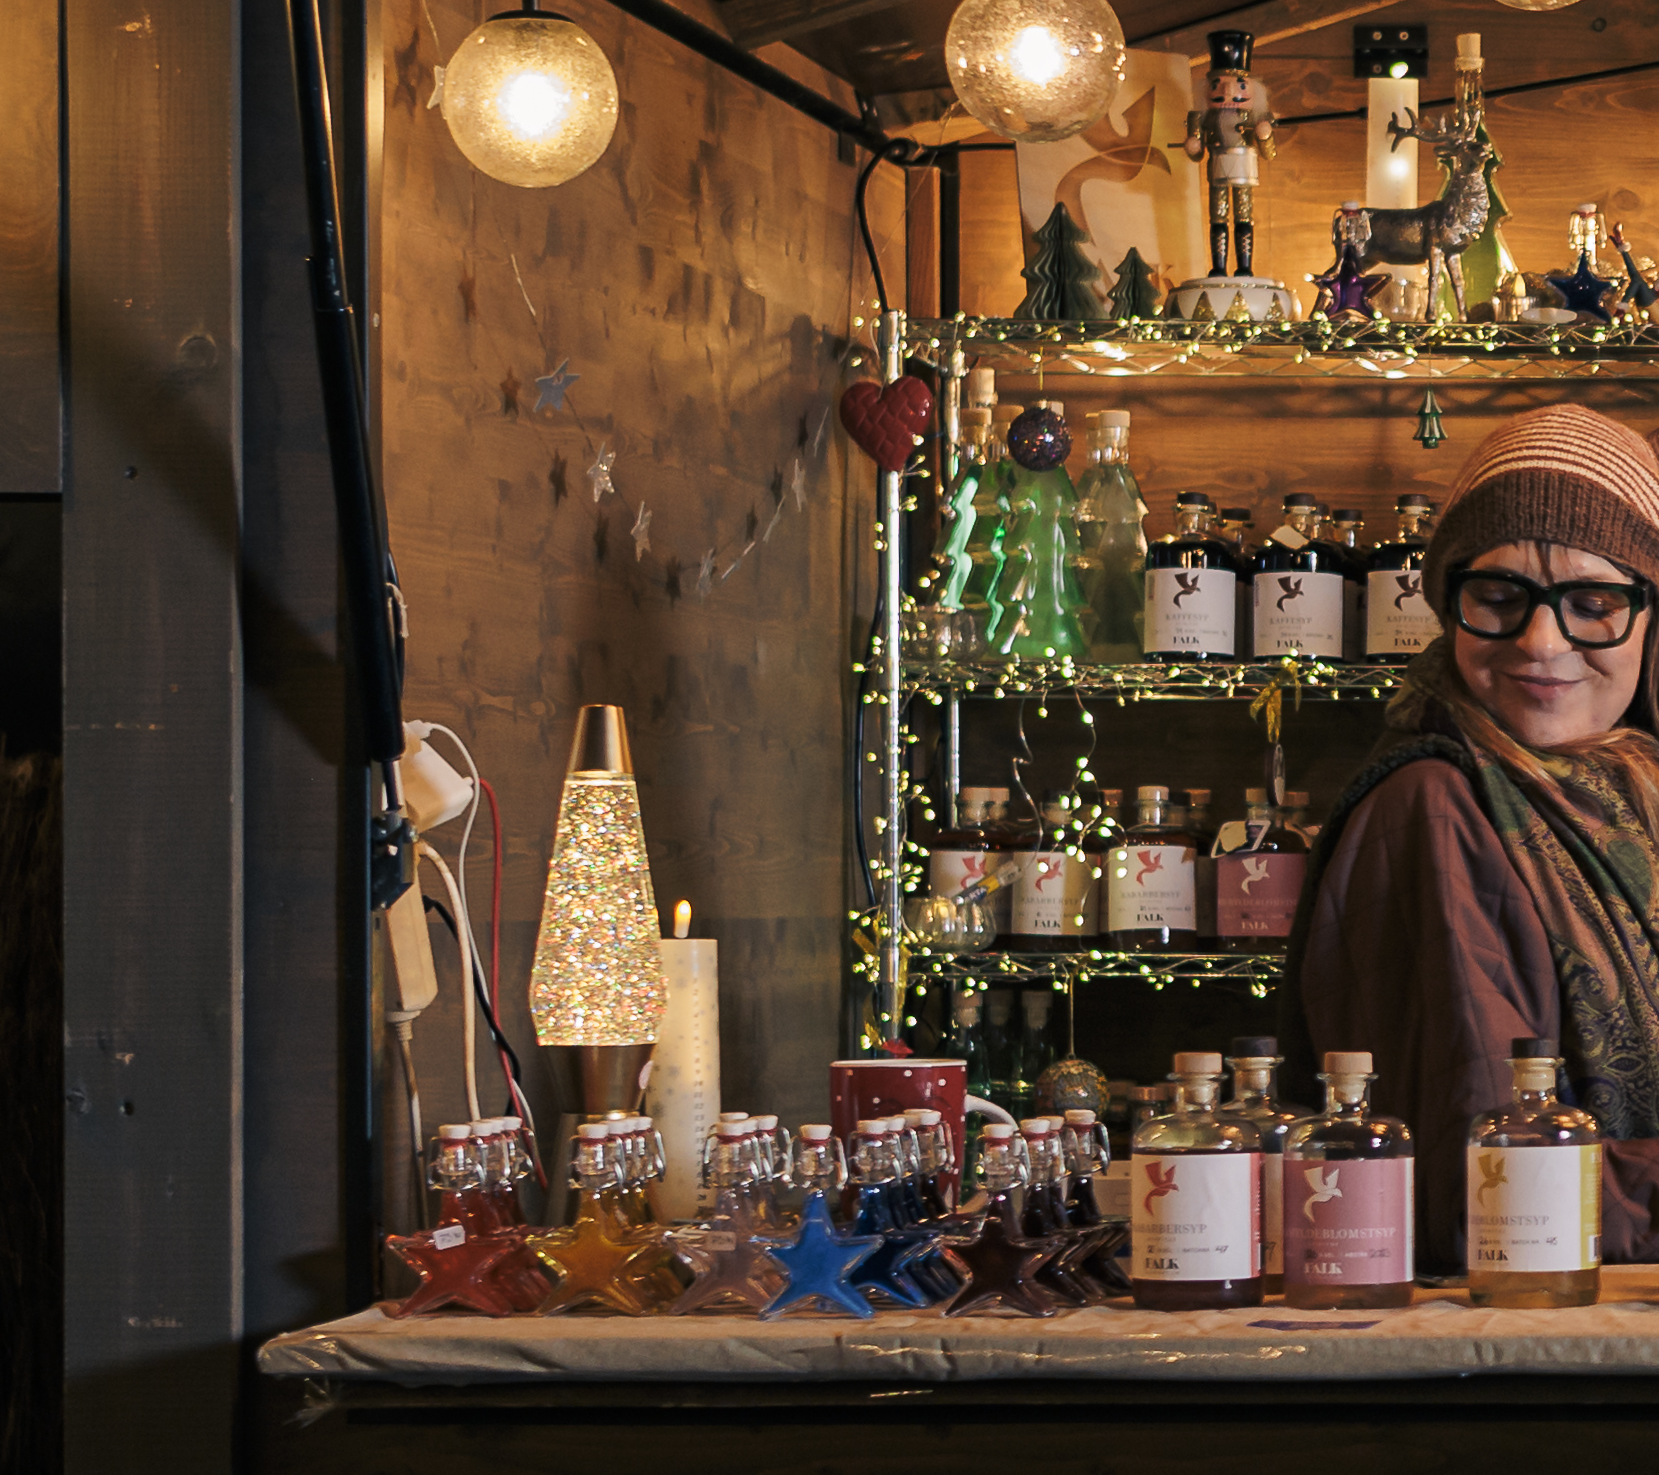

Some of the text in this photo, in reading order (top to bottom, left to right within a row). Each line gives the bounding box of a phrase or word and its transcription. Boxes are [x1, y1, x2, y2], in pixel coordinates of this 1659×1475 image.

[1173, 636, 1200, 644] FALK
[1276, 639, 1304, 649] FALK
[1394, 637, 1422, 646] FALK
[1136, 914, 1164, 922] FALK
[1478, 1249, 1508, 1261] FALK
[1145, 1257, 1180, 1269] FALK
[1304, 1262, 1343, 1274] FALK
